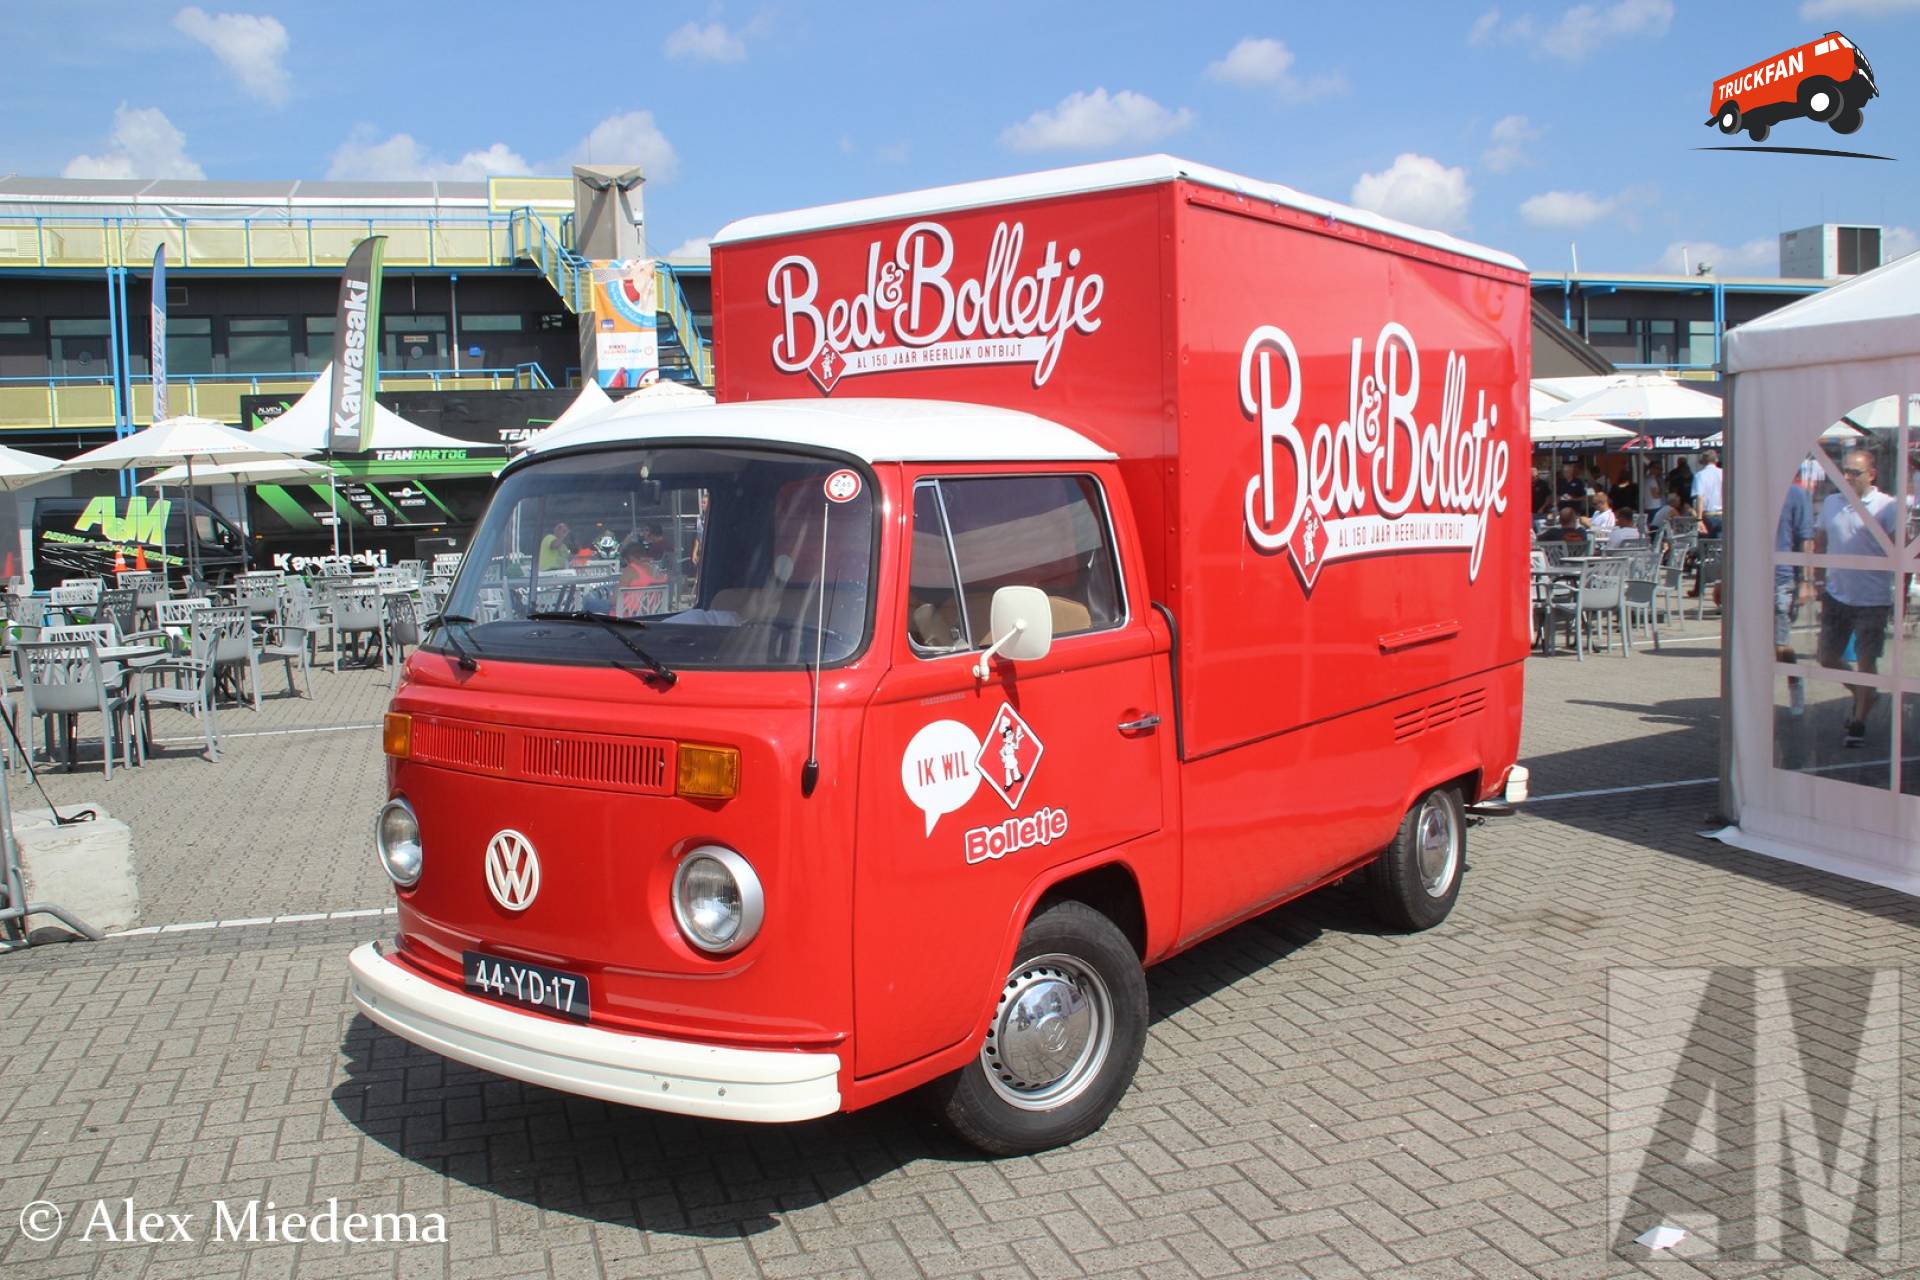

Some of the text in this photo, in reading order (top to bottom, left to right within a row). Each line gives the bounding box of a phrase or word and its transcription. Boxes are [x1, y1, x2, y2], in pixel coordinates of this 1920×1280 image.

[767, 222, 1104, 386] Bed & Bolletje
[334, 280, 369, 436] Kawasaki
[856, 343, 1023, 369] AL 150 JAAR HEERLIJK ONTBIJT
[376, 449, 468, 461] TEAMHARTOG
[1239, 321, 1509, 581] Bed & Bolletje
[1655, 435, 1700, 449] Karting
[1338, 522, 1465, 548] AL 150 JAAR HEERLIJK ONTBIJT
[917, 750, 969, 788] IK WIL
[965, 807, 1068, 864] Bolletje
